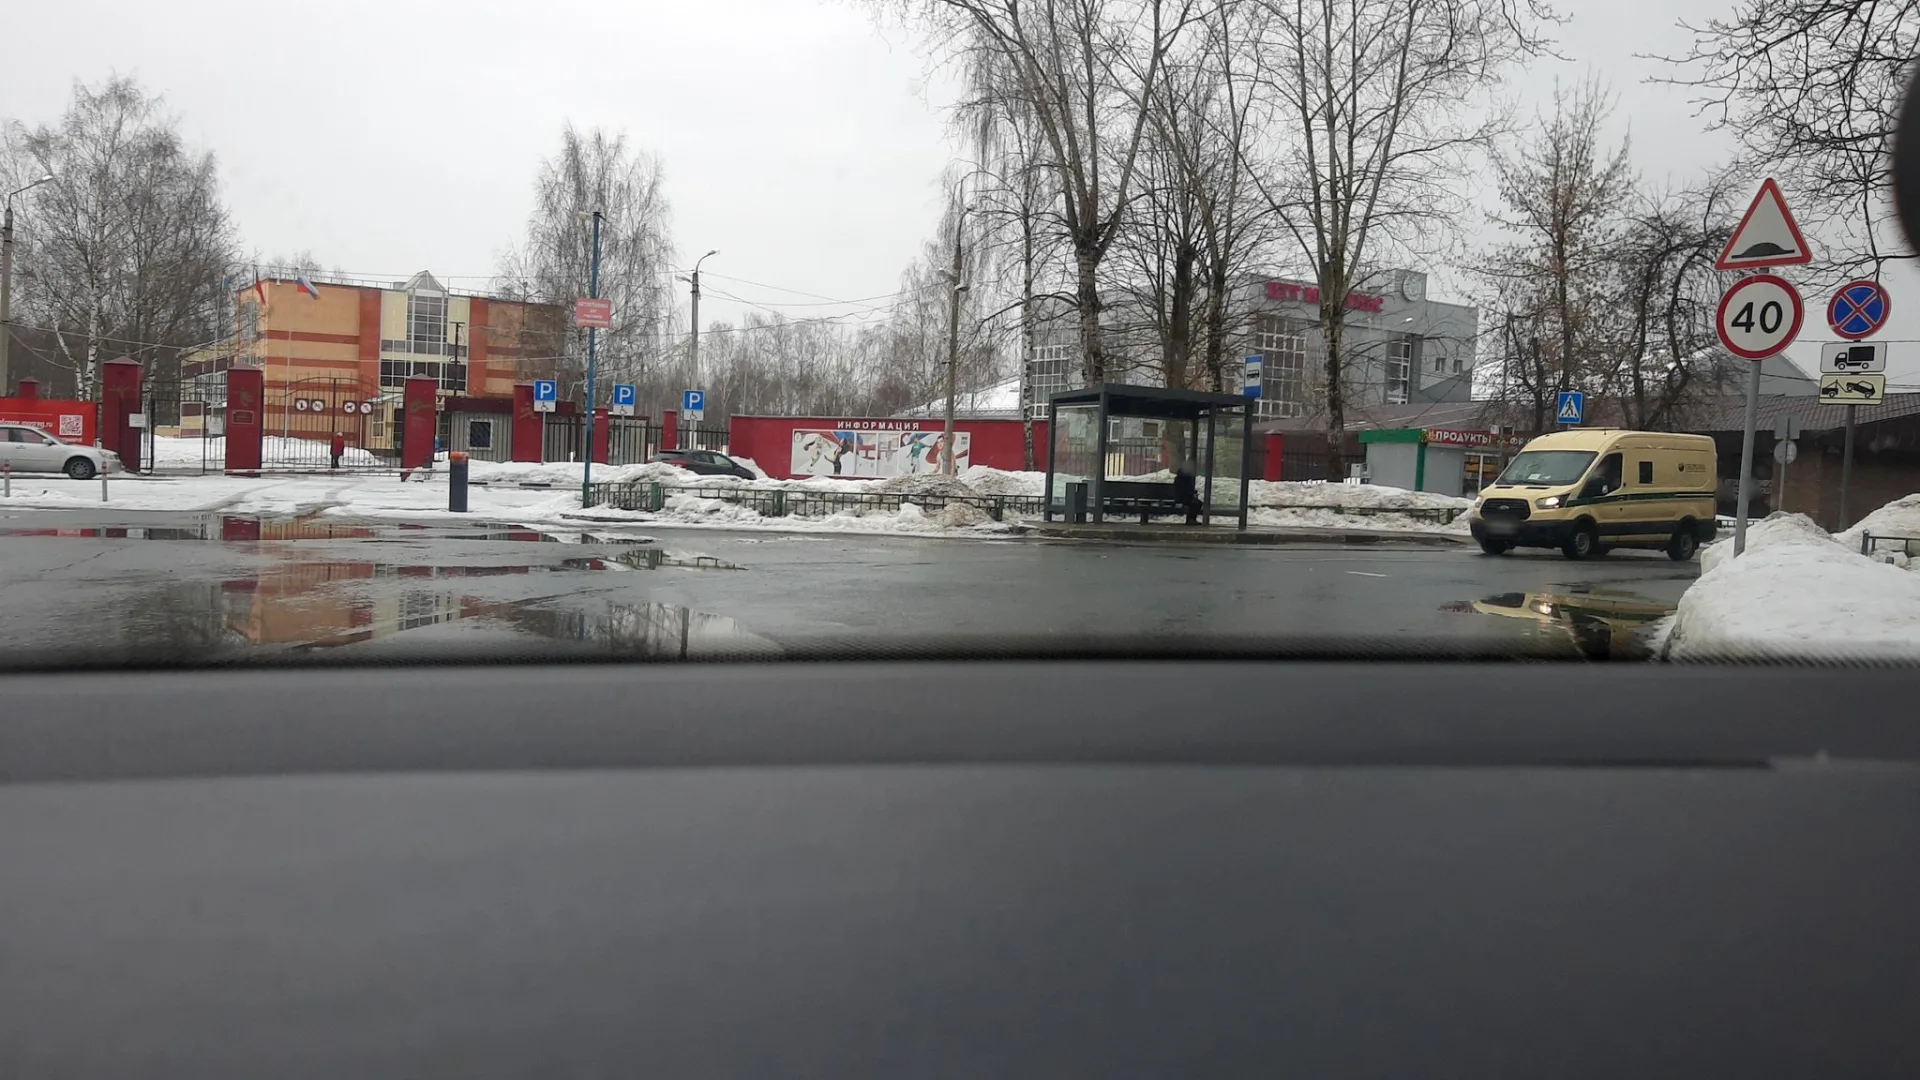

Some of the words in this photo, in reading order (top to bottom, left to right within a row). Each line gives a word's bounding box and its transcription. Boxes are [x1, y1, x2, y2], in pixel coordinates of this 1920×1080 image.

[1731, 301, 1783, 334] 40
[540, 383, 552, 399] P
[619, 387, 631, 402] P
[689, 392, 700, 408] P
[838, 421, 920, 431] ИНФОРМАЦИЯ
[1435, 431, 1492, 443] ПРОДУКТЫ
